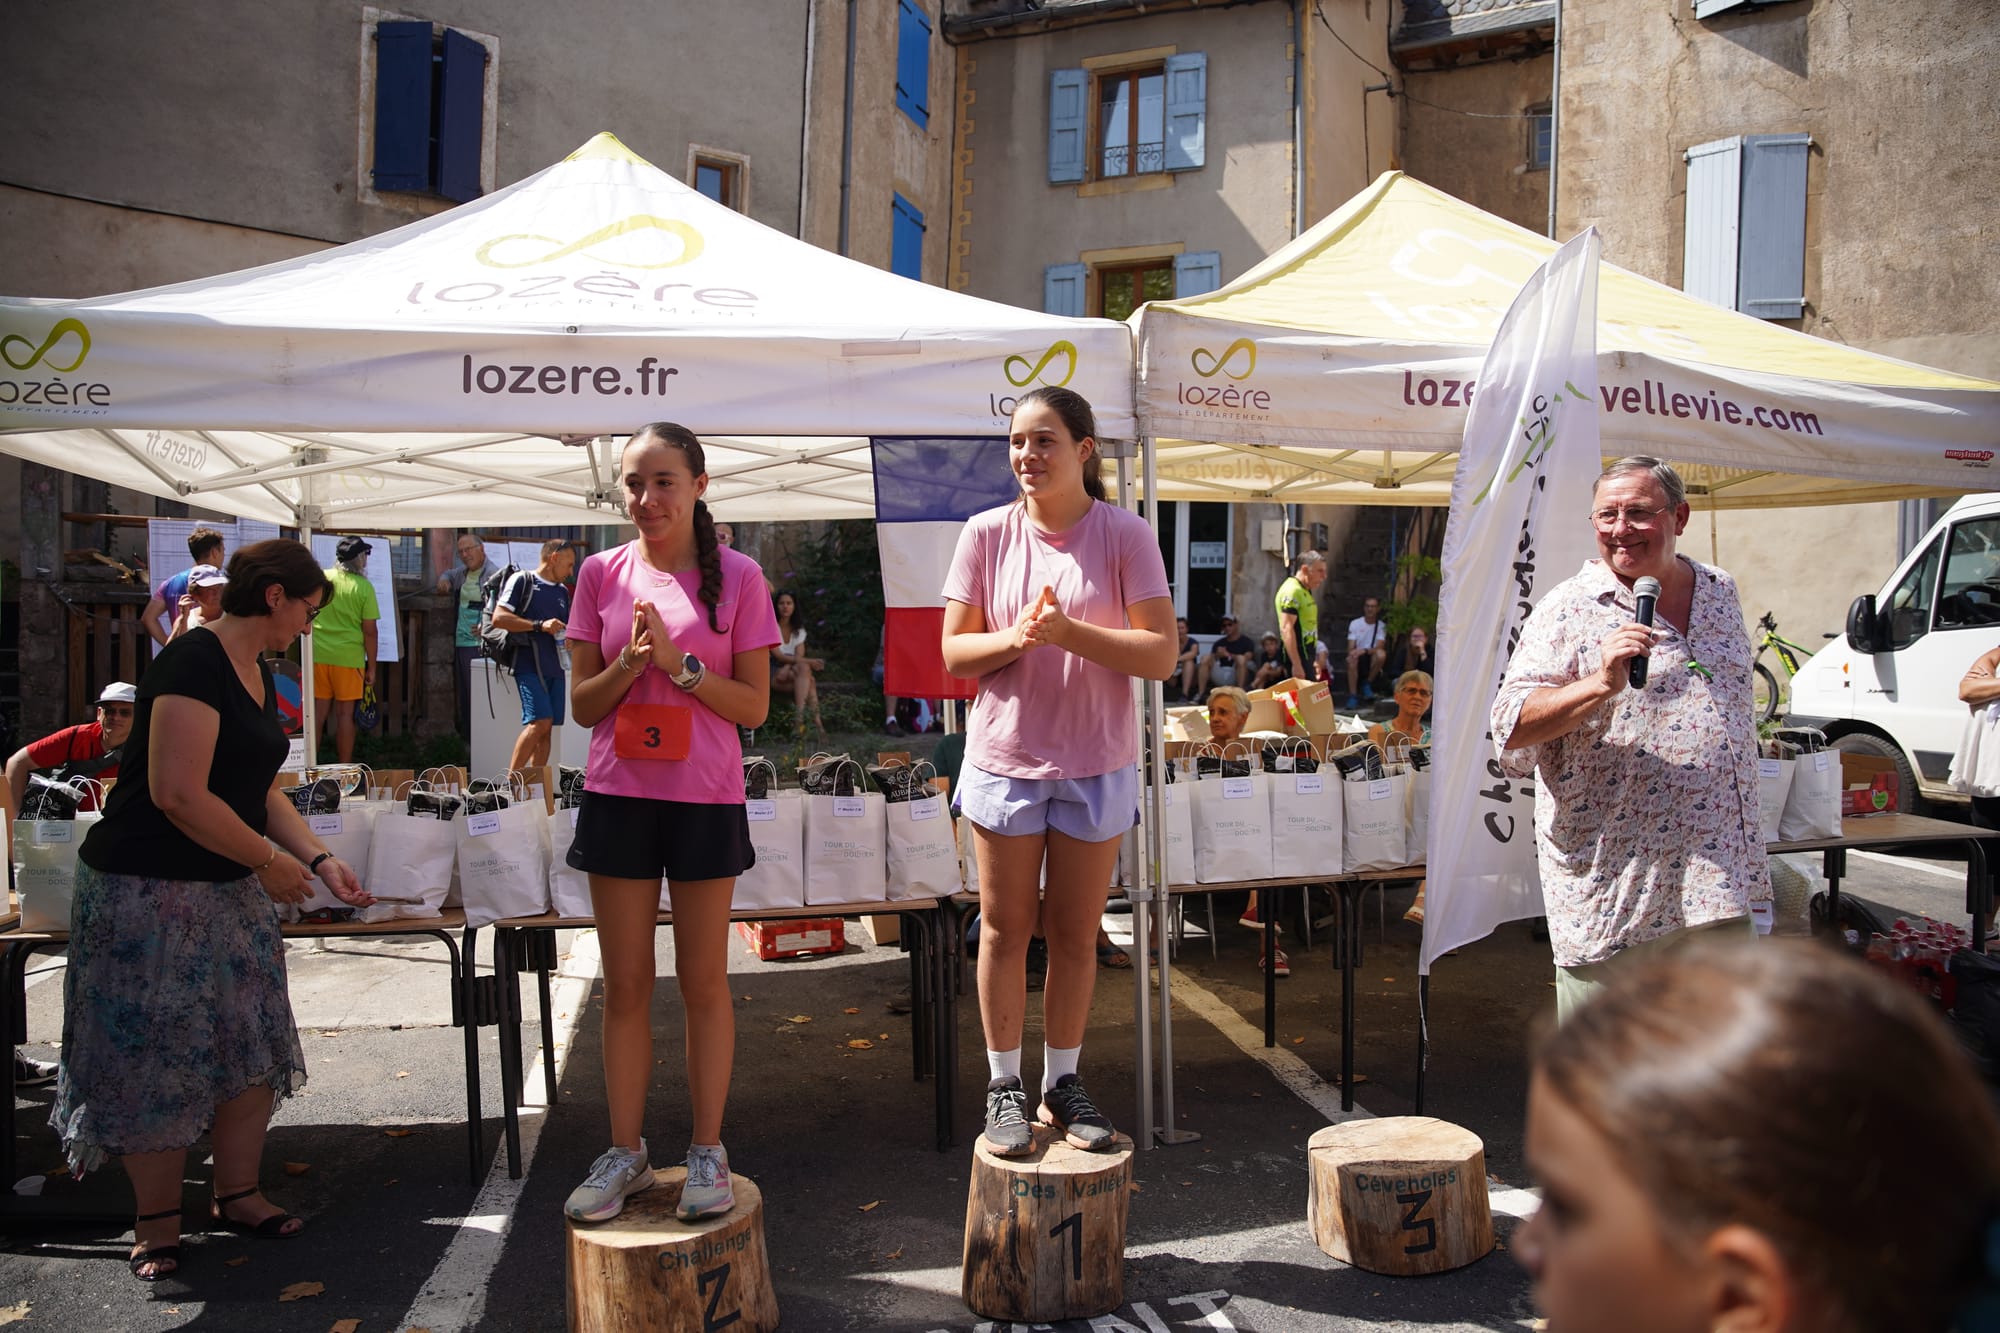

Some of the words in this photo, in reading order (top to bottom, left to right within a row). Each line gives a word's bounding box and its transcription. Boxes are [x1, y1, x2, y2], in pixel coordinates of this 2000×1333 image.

[406, 271, 759, 308] lozère
[463, 354, 679, 396] lozere.fr
[1178, 382, 1271, 410] lozère
[643, 726, 661, 748] 3
[824, 840, 843, 848] TOUR
[906, 845, 924, 854] TOUR
[1015, 1178, 1055, 1199] Des
[1356, 1167, 1456, 1192] Cévenoles
[1396, 1190, 1437, 1255] 3
[658, 1226, 752, 1270] Challenge
[1050, 1212, 1082, 1281] 1
